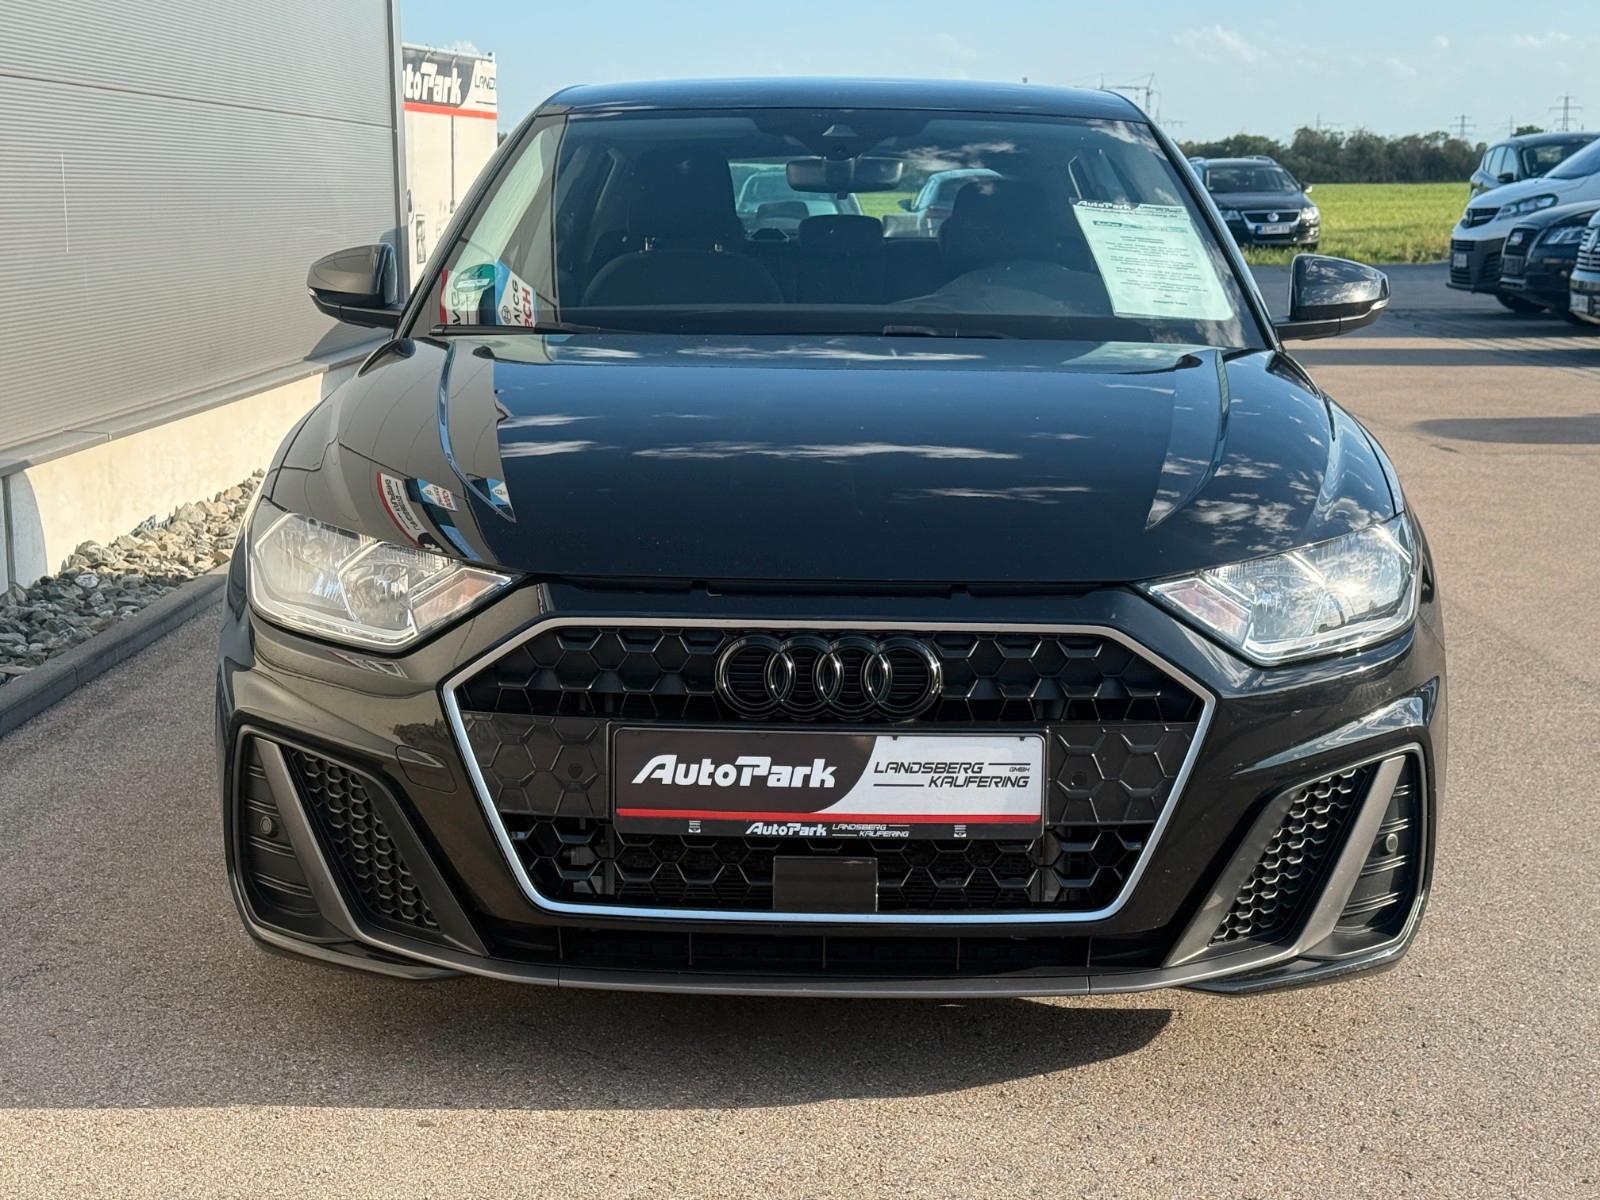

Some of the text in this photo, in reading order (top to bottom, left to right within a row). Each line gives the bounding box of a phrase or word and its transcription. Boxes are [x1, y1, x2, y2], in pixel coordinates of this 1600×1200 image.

[631, 754, 838, 788] AutoPark
[874, 761, 984, 774] LANDSBERG
[928, 775, 1030, 788] KAUFERING
[745, 822, 827, 836] AutoPark
[832, 823, 887, 831] LANDSBERG
[859, 830, 909, 838] KAUFERING
